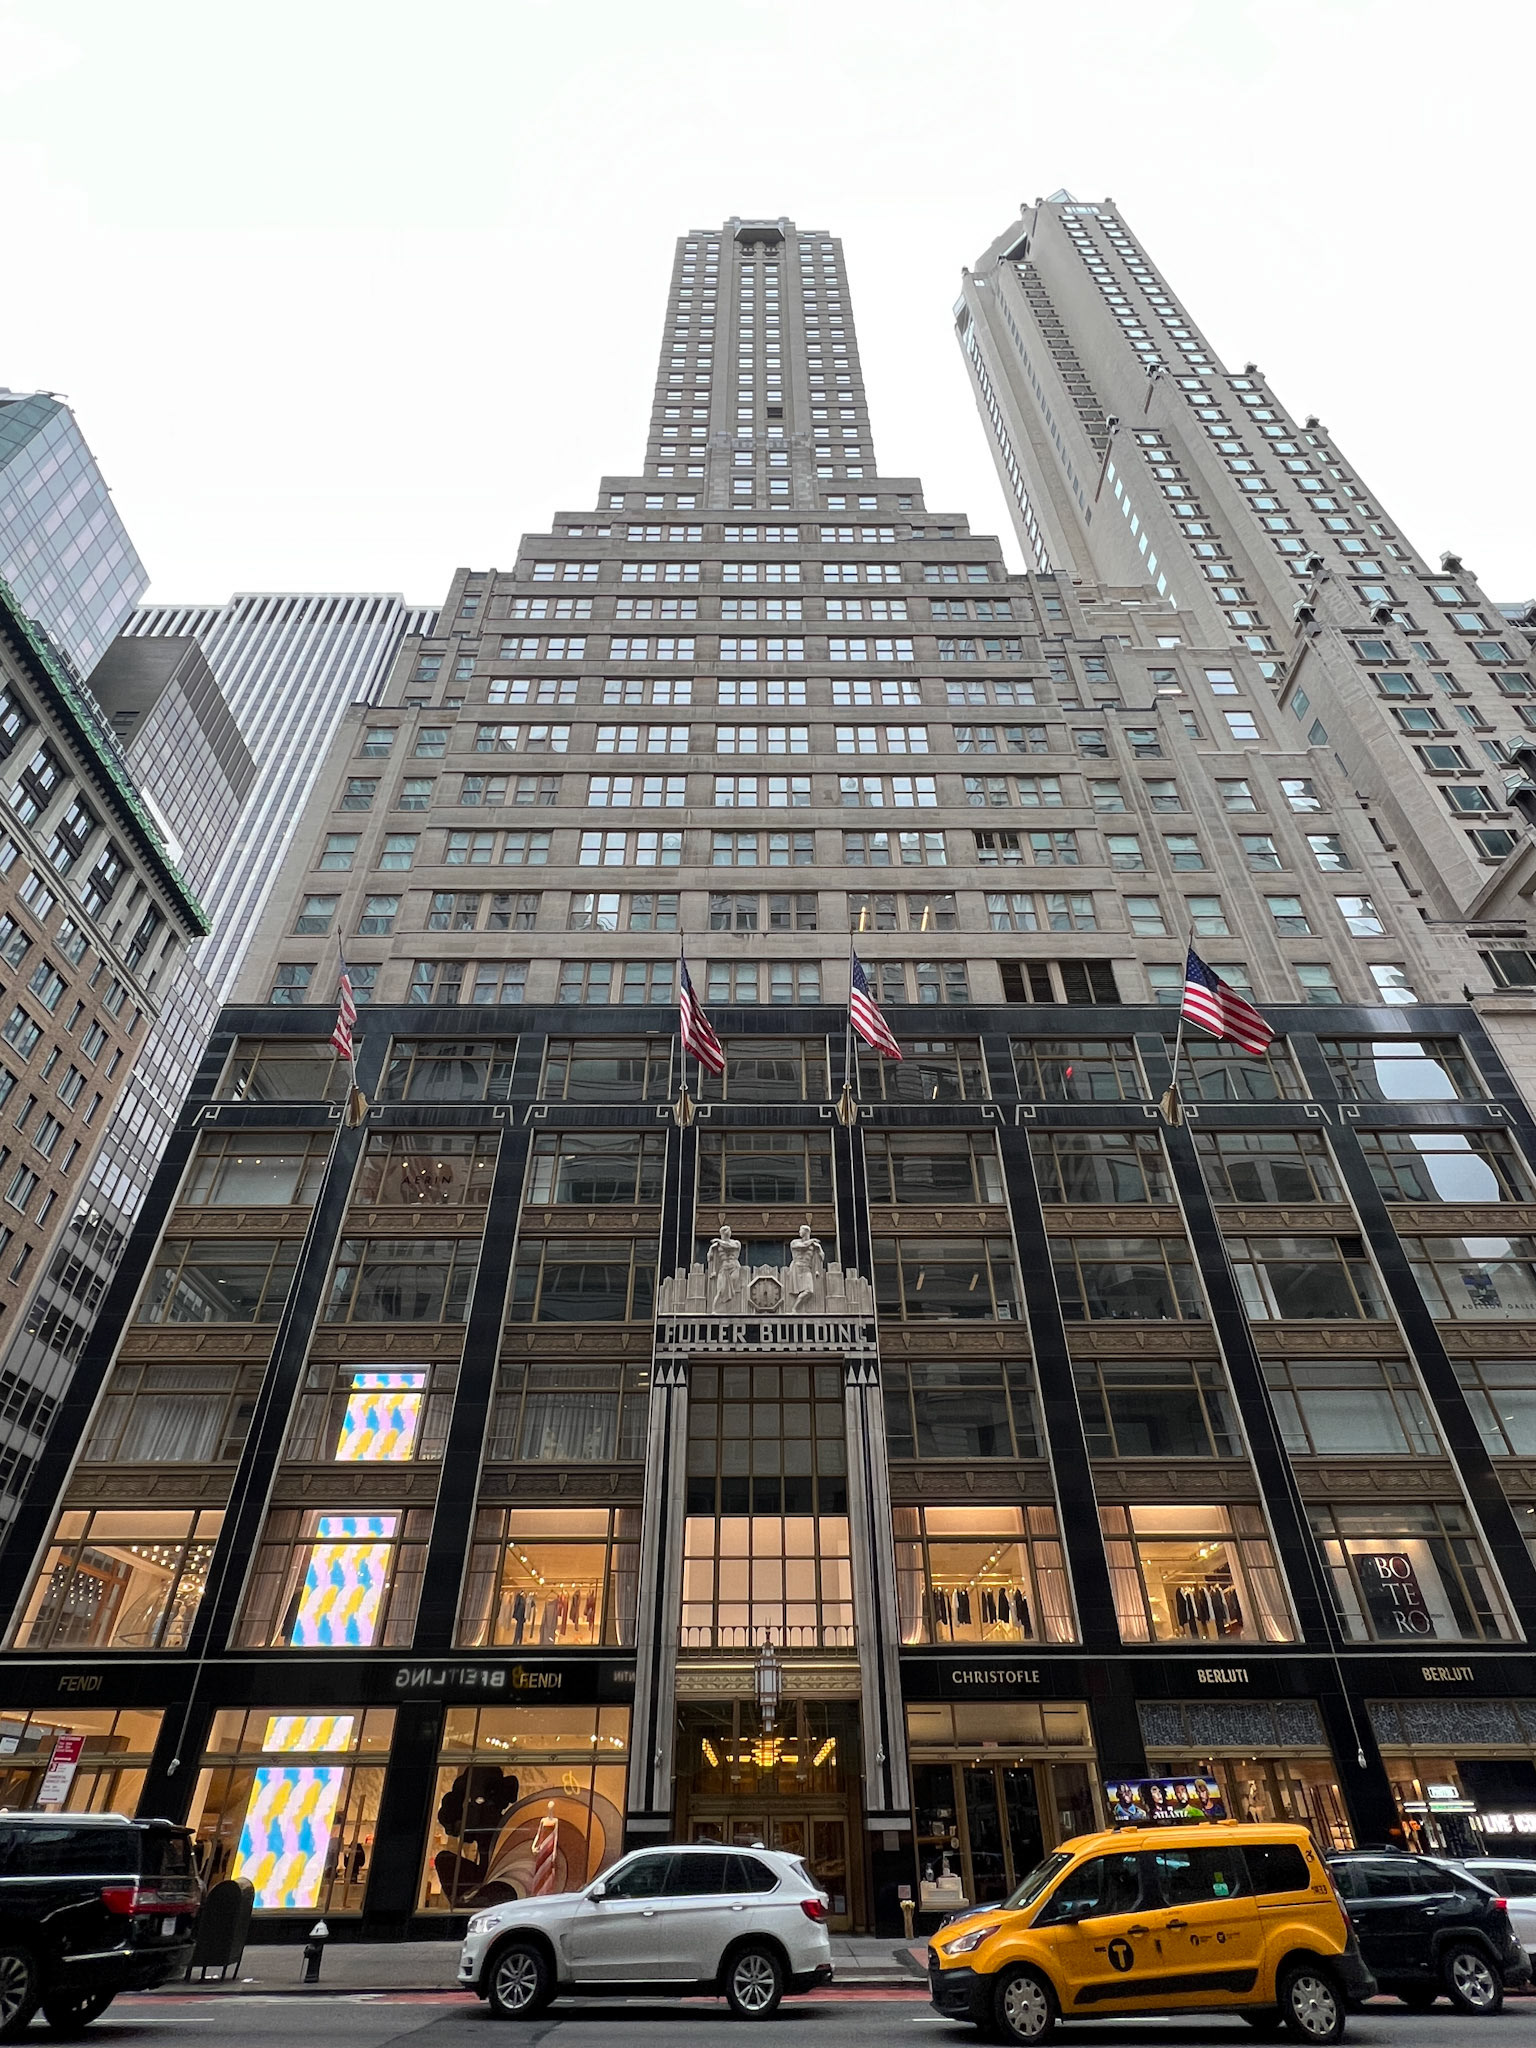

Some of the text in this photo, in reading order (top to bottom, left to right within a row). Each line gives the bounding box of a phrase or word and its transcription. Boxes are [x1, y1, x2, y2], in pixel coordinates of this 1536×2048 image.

[401, 1176, 453, 1184] AERIN
[665, 1323, 868, 1343] FULLER BUILDING
[1374, 1556, 1411, 1579] BO
[1381, 1583, 1420, 1606] TE
[1392, 1610, 1431, 1634] RO
[520, 1672, 562, 1688] FENDI
[951, 1670, 1041, 1684] CHRISTOFLE
[1197, 1668, 1249, 1683] BERLUTI
[1421, 1666, 1475, 1681] BERLUTI
[57, 1675, 103, 1691] FENDI
